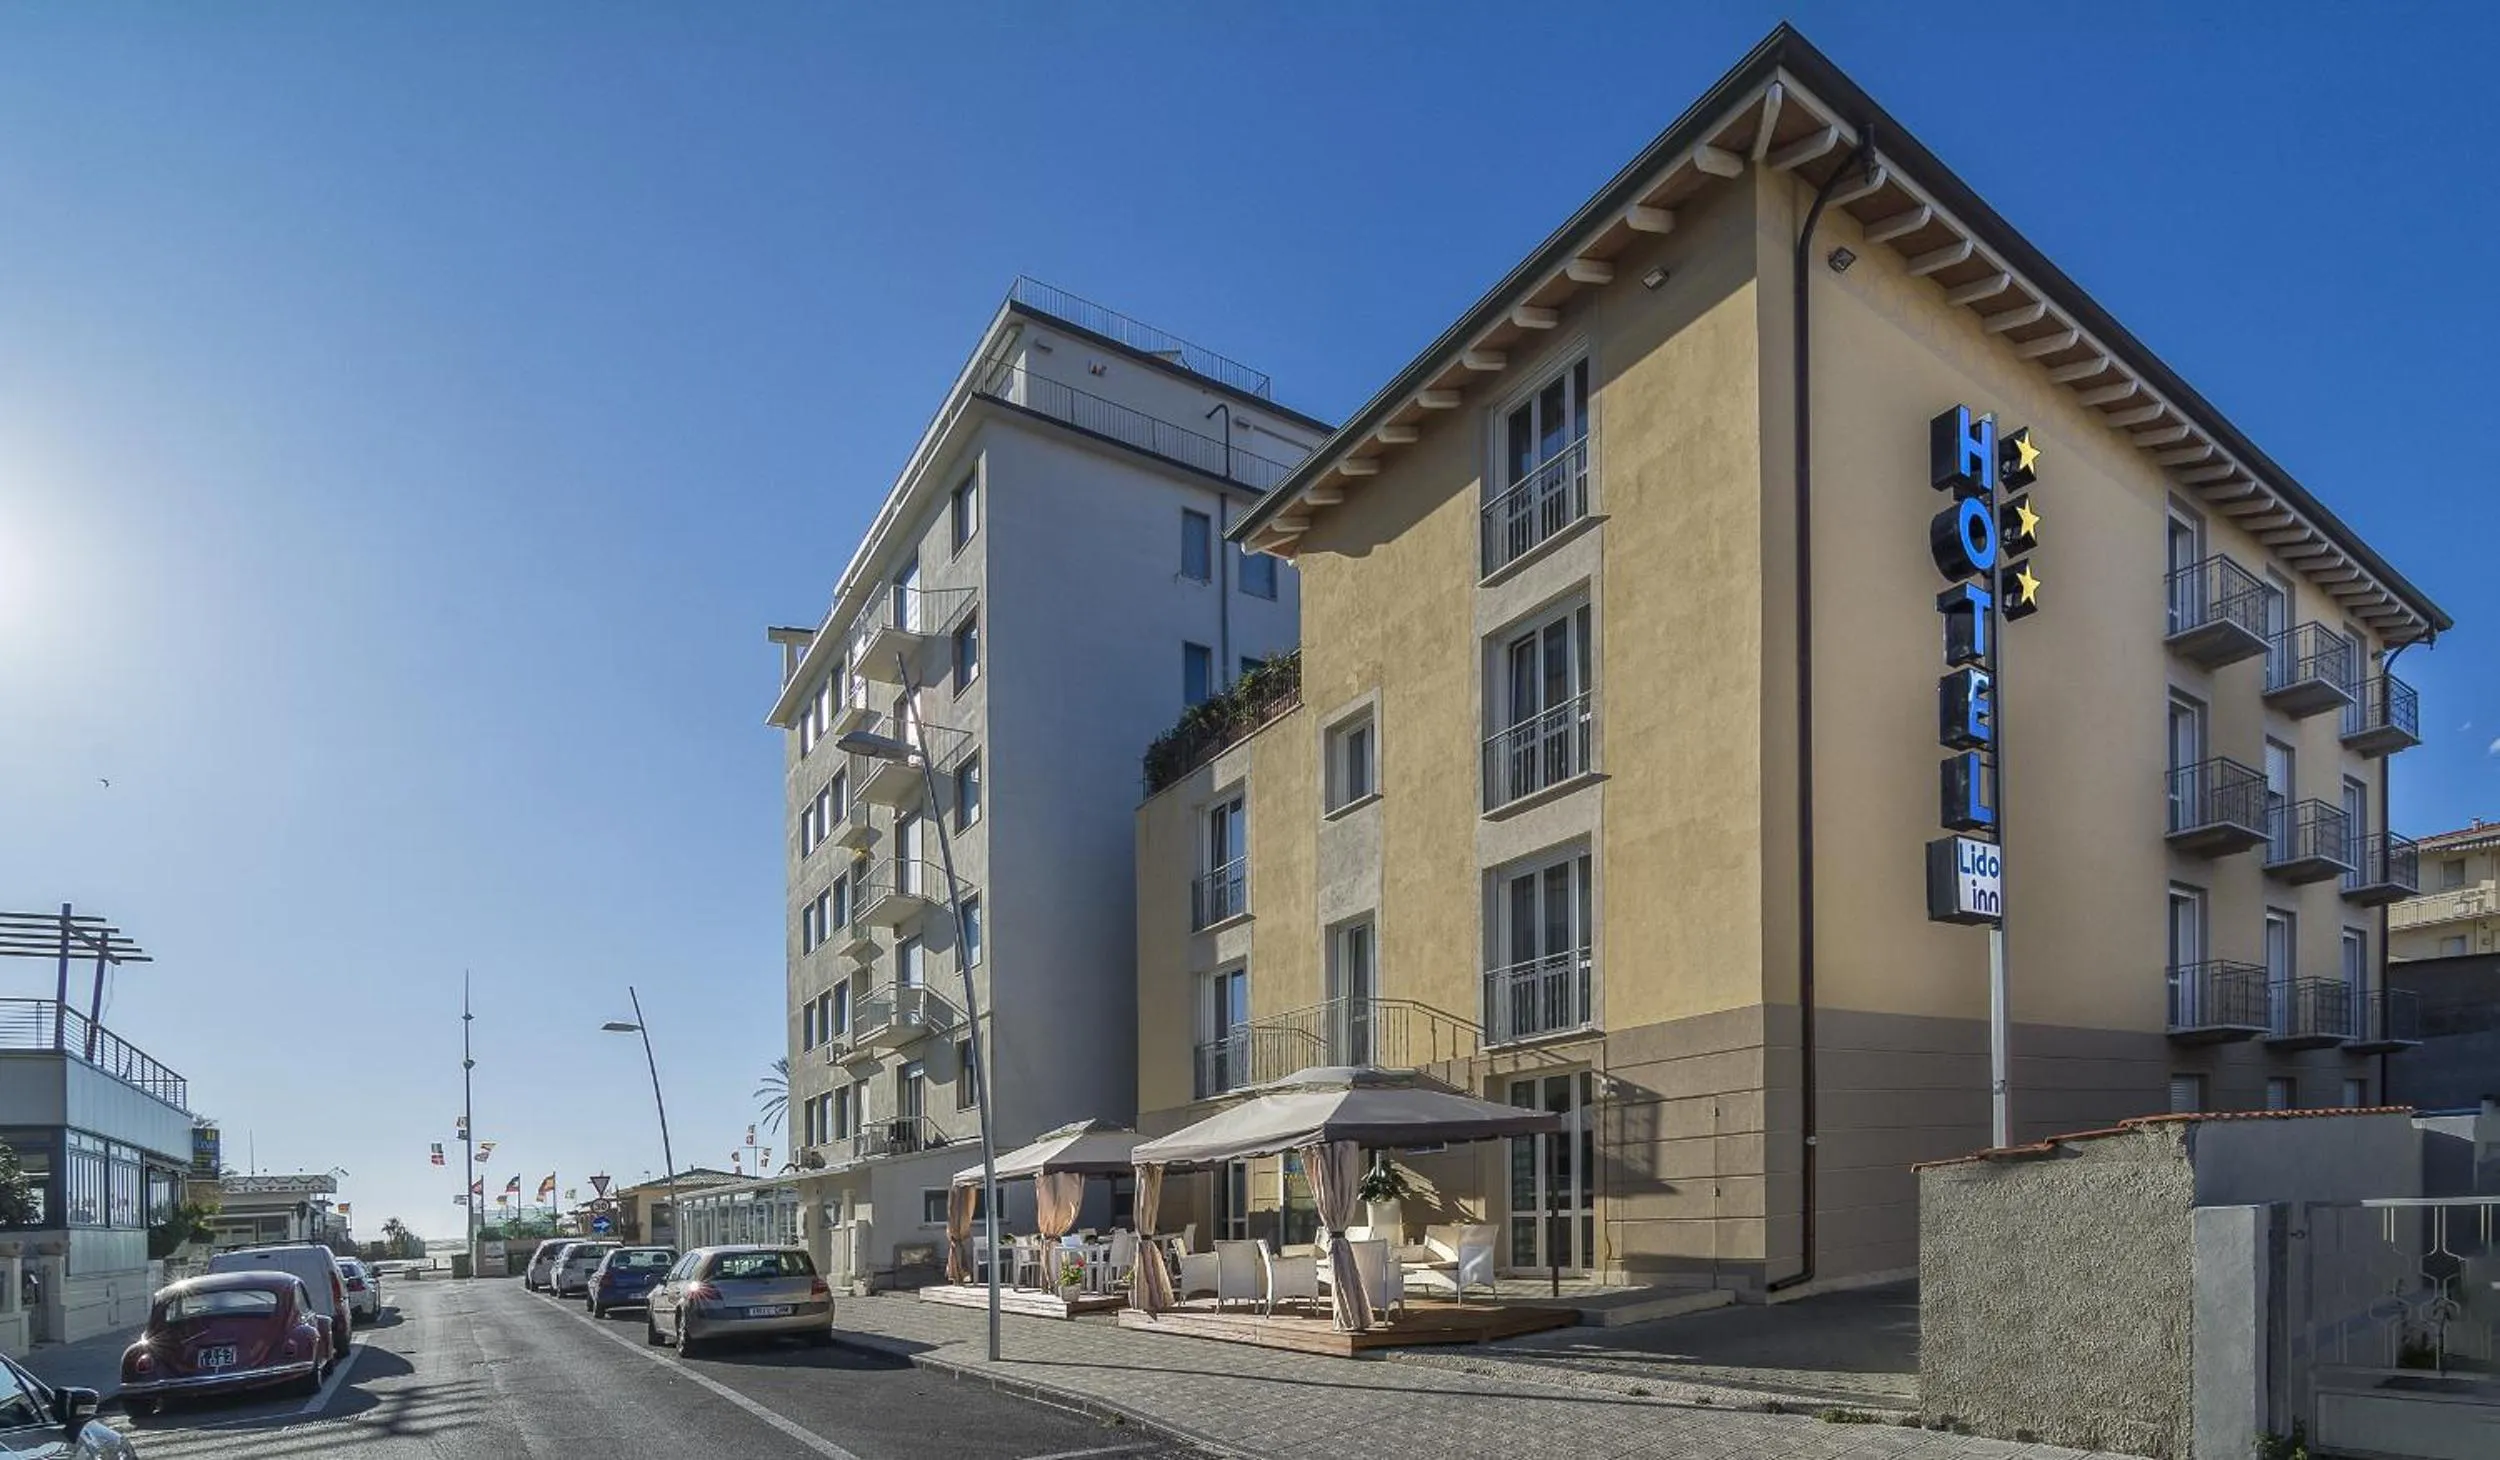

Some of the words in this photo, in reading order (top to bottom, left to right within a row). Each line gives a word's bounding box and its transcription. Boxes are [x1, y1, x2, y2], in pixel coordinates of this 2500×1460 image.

[1957, 404, 1997, 824] HOTEL
[1959, 842, 1999, 879] Lido
[1971, 879, 1999, 914] inn
